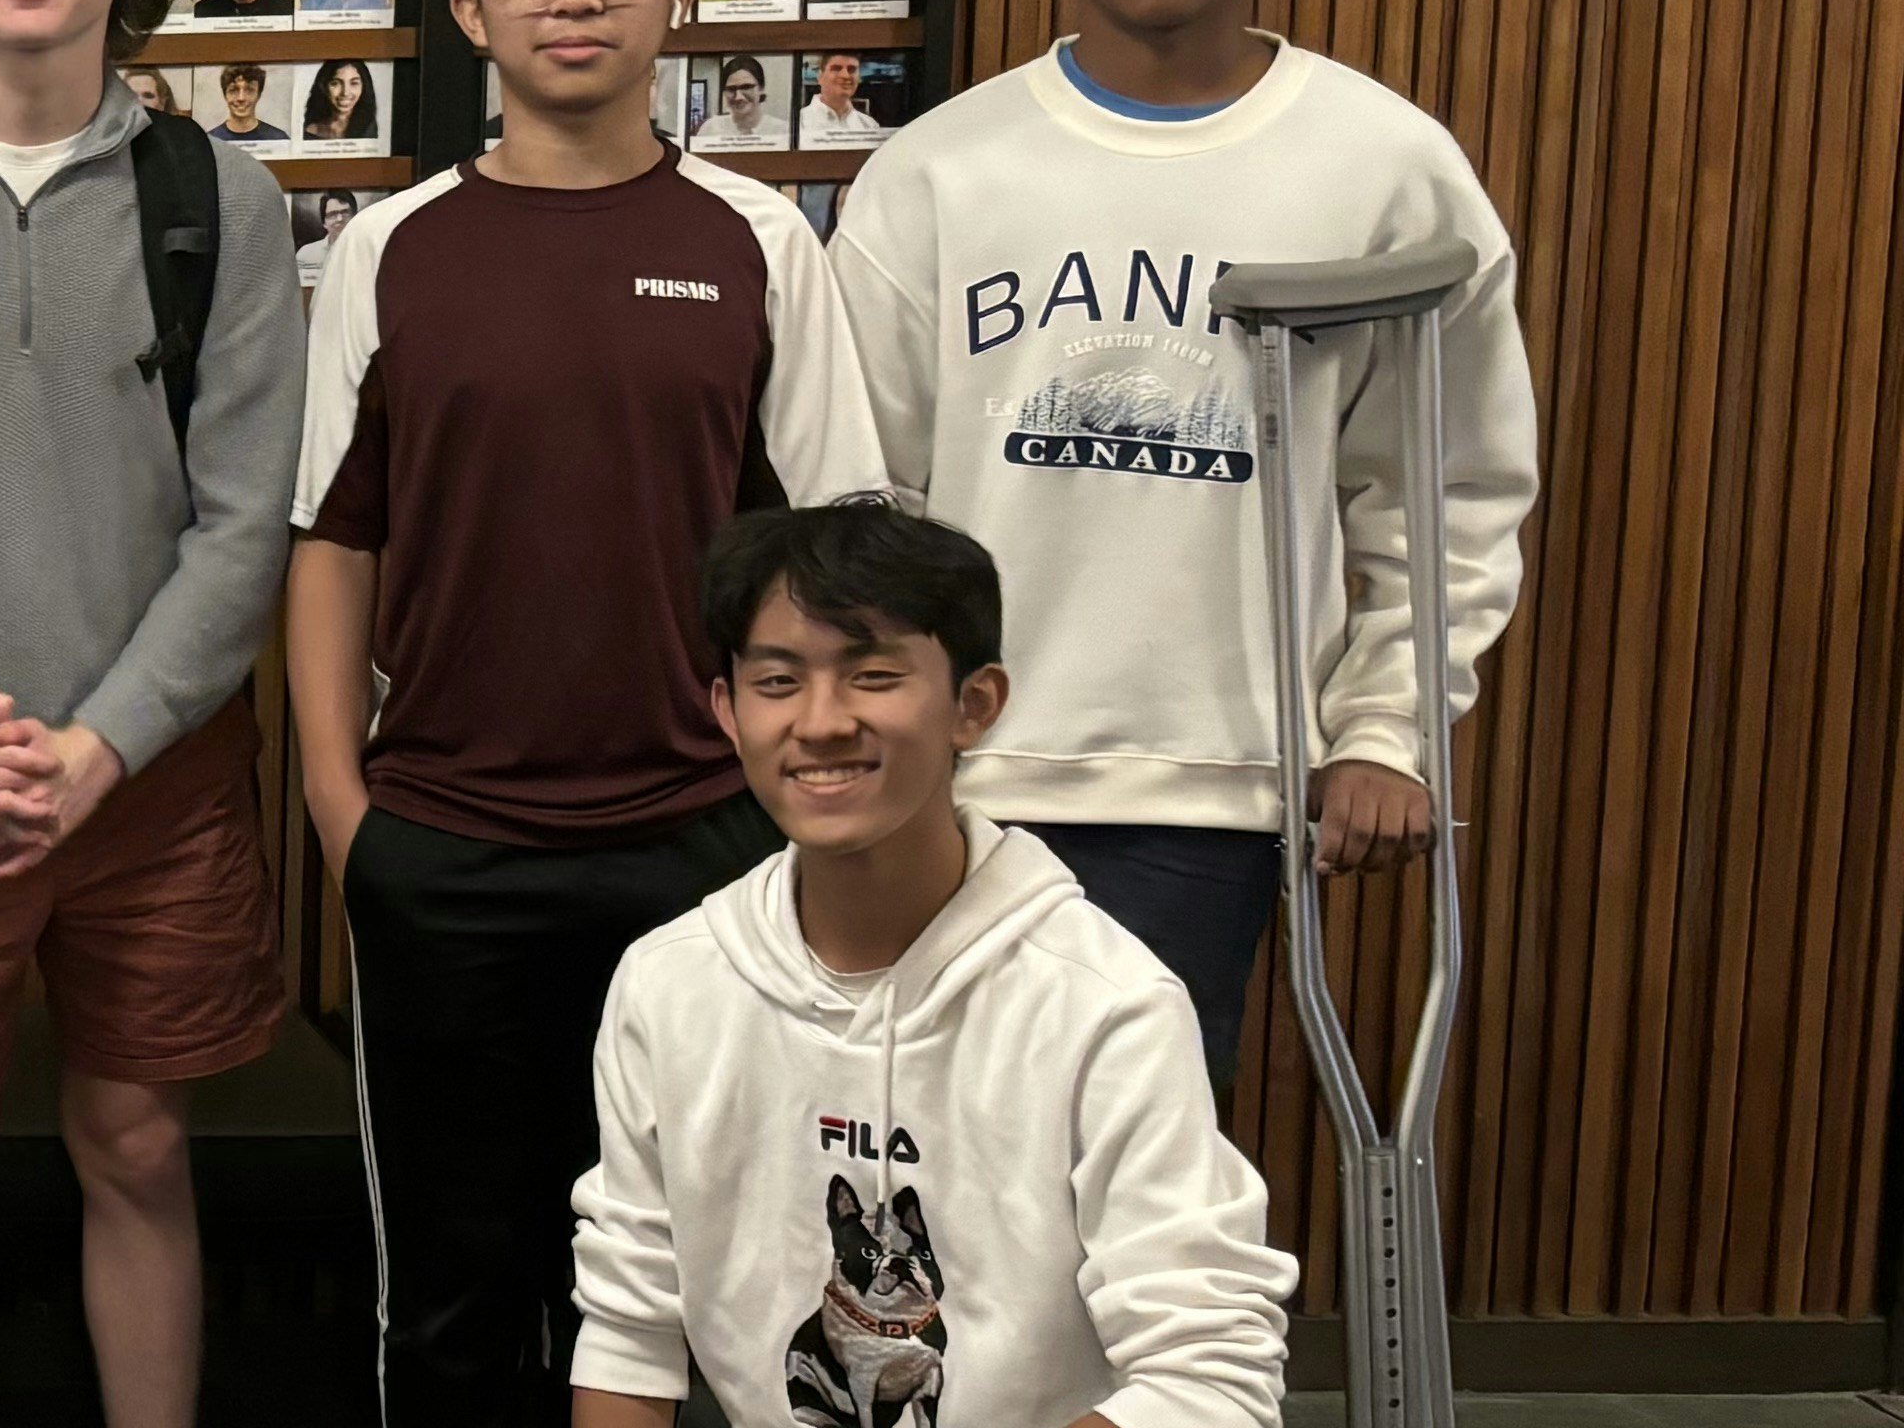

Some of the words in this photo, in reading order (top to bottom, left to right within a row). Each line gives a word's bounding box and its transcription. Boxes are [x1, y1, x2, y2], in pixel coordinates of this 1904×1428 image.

[634, 277, 720, 302] PRISMS
[965, 248, 1235, 356] BAN
[1063, 333, 1155, 358] ELEVATION
[1021, 437, 1234, 479] CANADA
[818, 1114, 920, 1165] FILA
